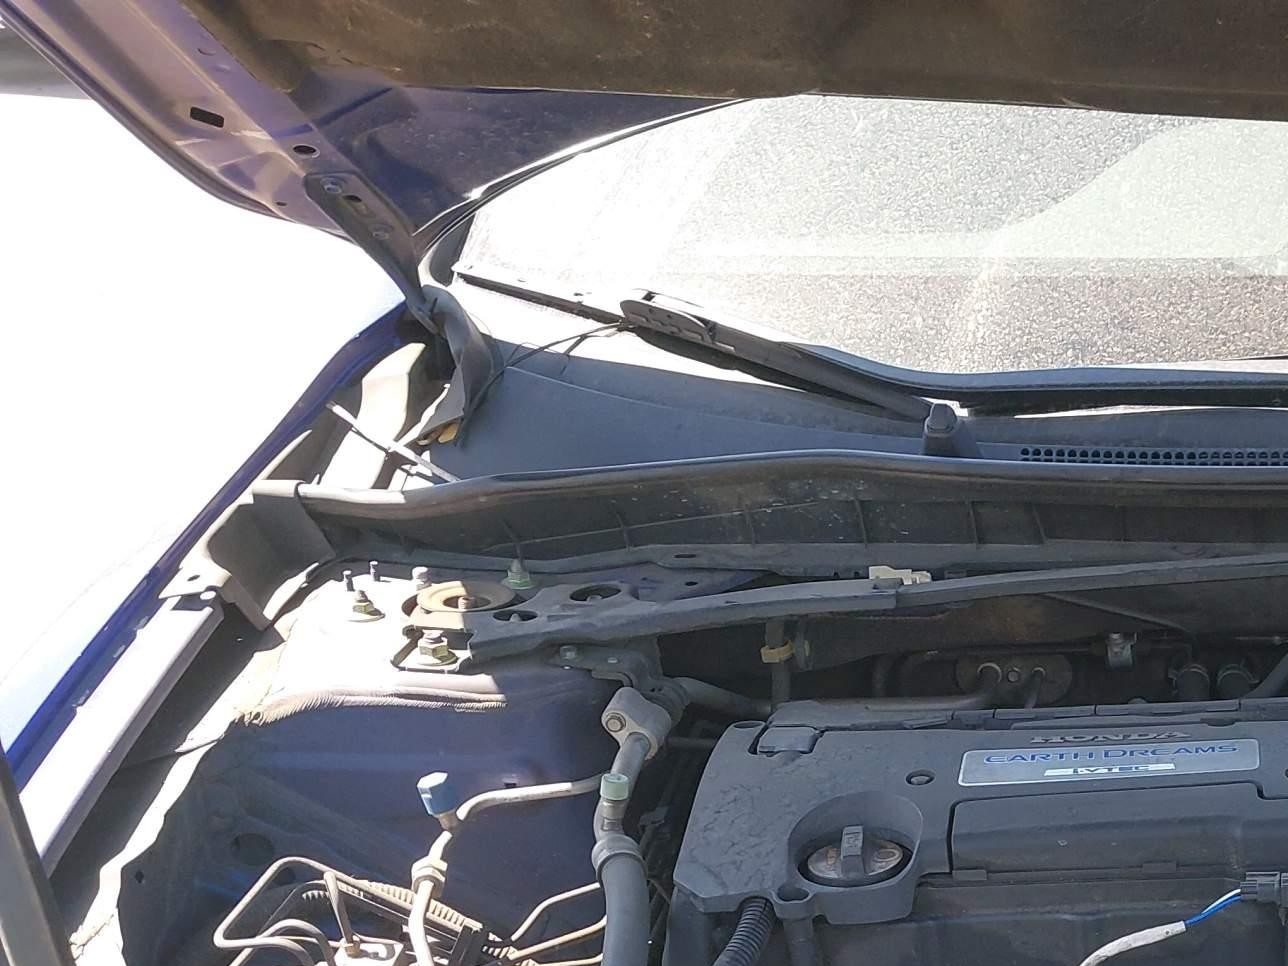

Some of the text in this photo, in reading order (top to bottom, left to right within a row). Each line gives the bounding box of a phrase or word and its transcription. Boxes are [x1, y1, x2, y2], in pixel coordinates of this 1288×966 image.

[1031, 731, 1190, 744] HONDA
[984, 743, 1239, 764] EARTH DREAMS
